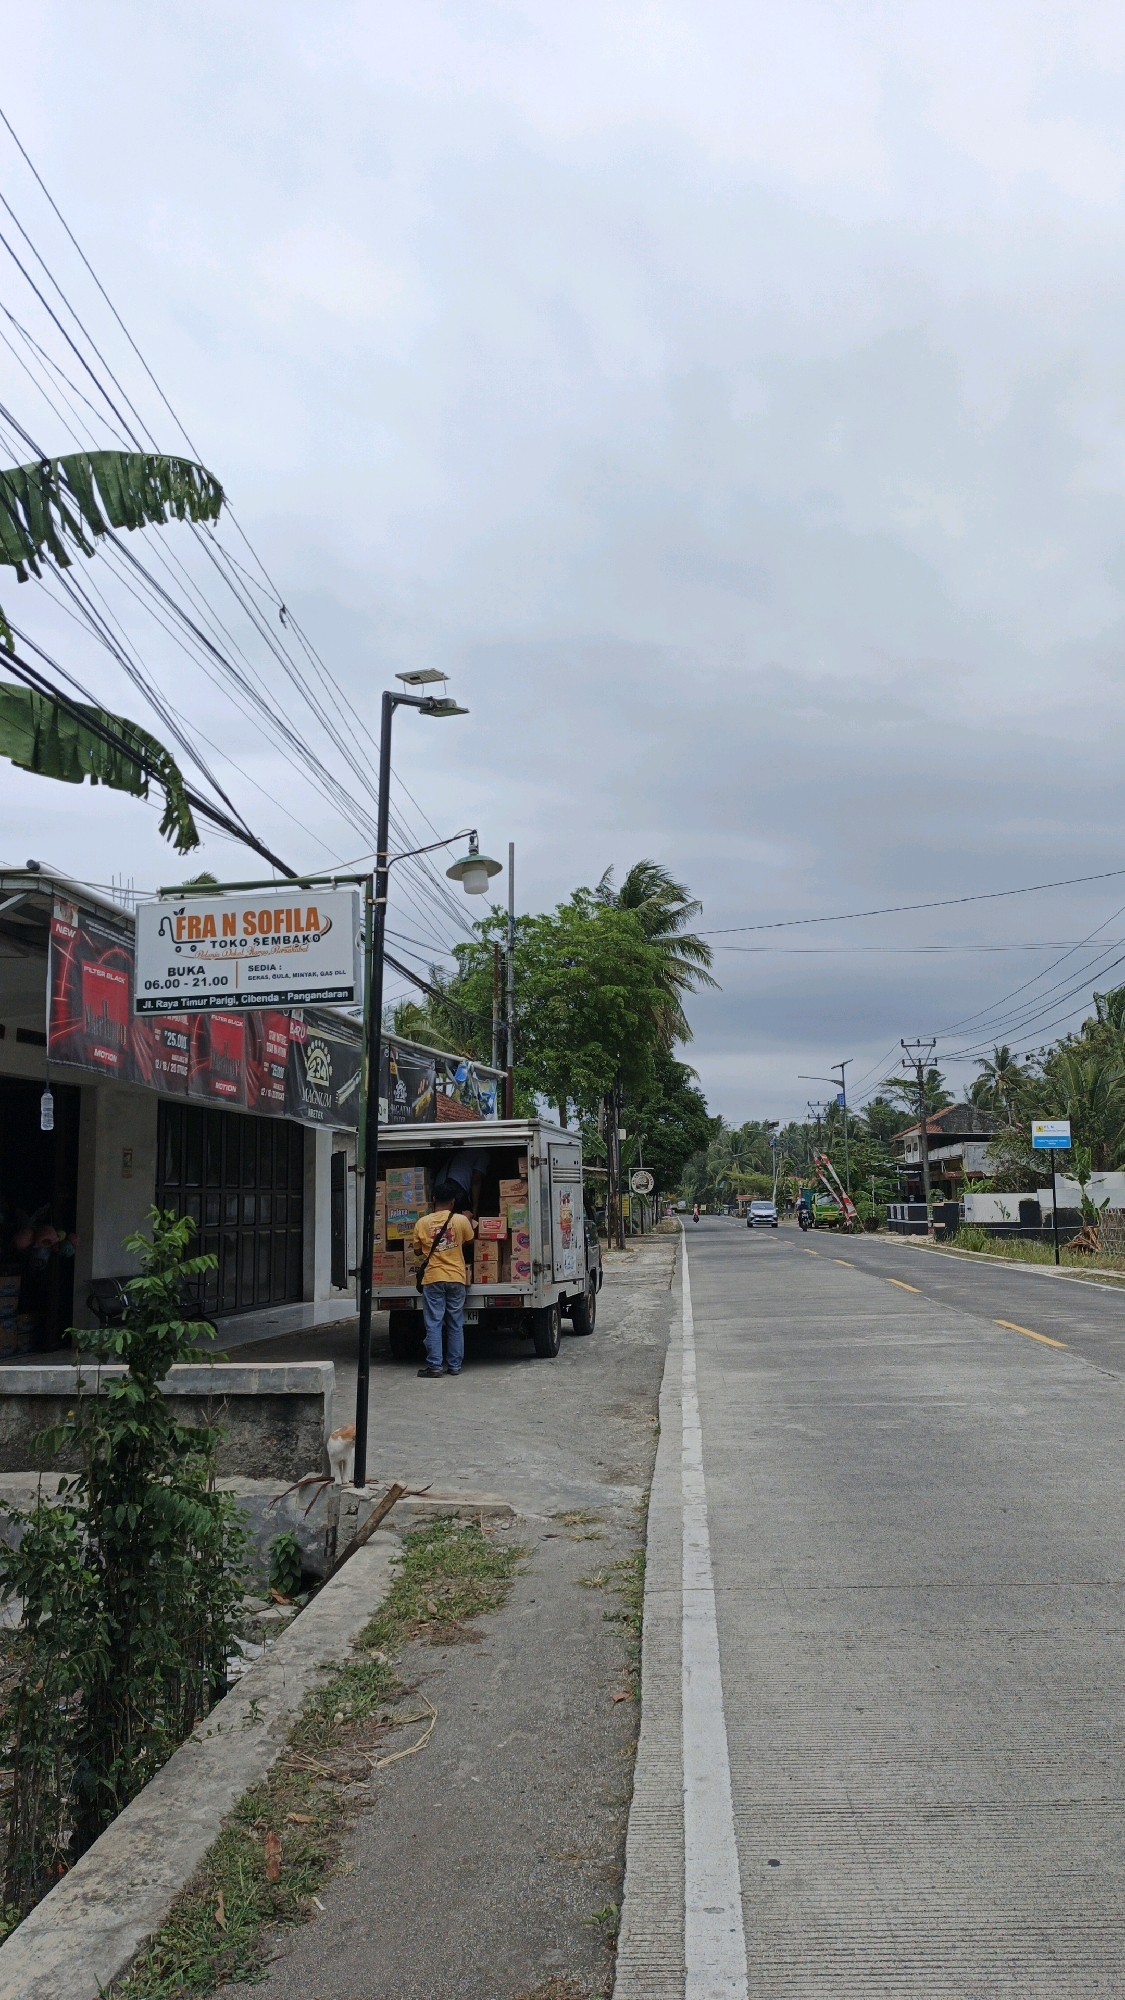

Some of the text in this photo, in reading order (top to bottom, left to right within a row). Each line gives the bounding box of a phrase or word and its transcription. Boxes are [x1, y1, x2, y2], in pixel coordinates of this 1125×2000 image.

[55, 923, 77, 938] NEW
[176, 906, 321, 941] FRA N SOFILA
[210, 933, 321, 949] TOKO SEMBAKO
[83, 964, 126, 985] FILTER BLACK
[167, 965, 206, 977] BUKA
[248, 964, 277, 972] SEDIA
[144, 978, 180, 991] 06.00
[192, 976, 229, 988] 21.00
[155, 998, 179, 1009] Raya
[180, 996, 208, 1007] Timur
[209, 994, 239, 1006] Parigi,
[241, 992, 280, 1003] Cibenda
[287, 989, 349, 1001] Pangandaran
[93, 1048, 118, 1063] MOTION
[308, 1057, 328, 1082] 234
[215, 1081, 237, 1093] MOTION
[302, 1086, 332, 1108] MAGNUM
[467, 1311, 478, 1321] KH
